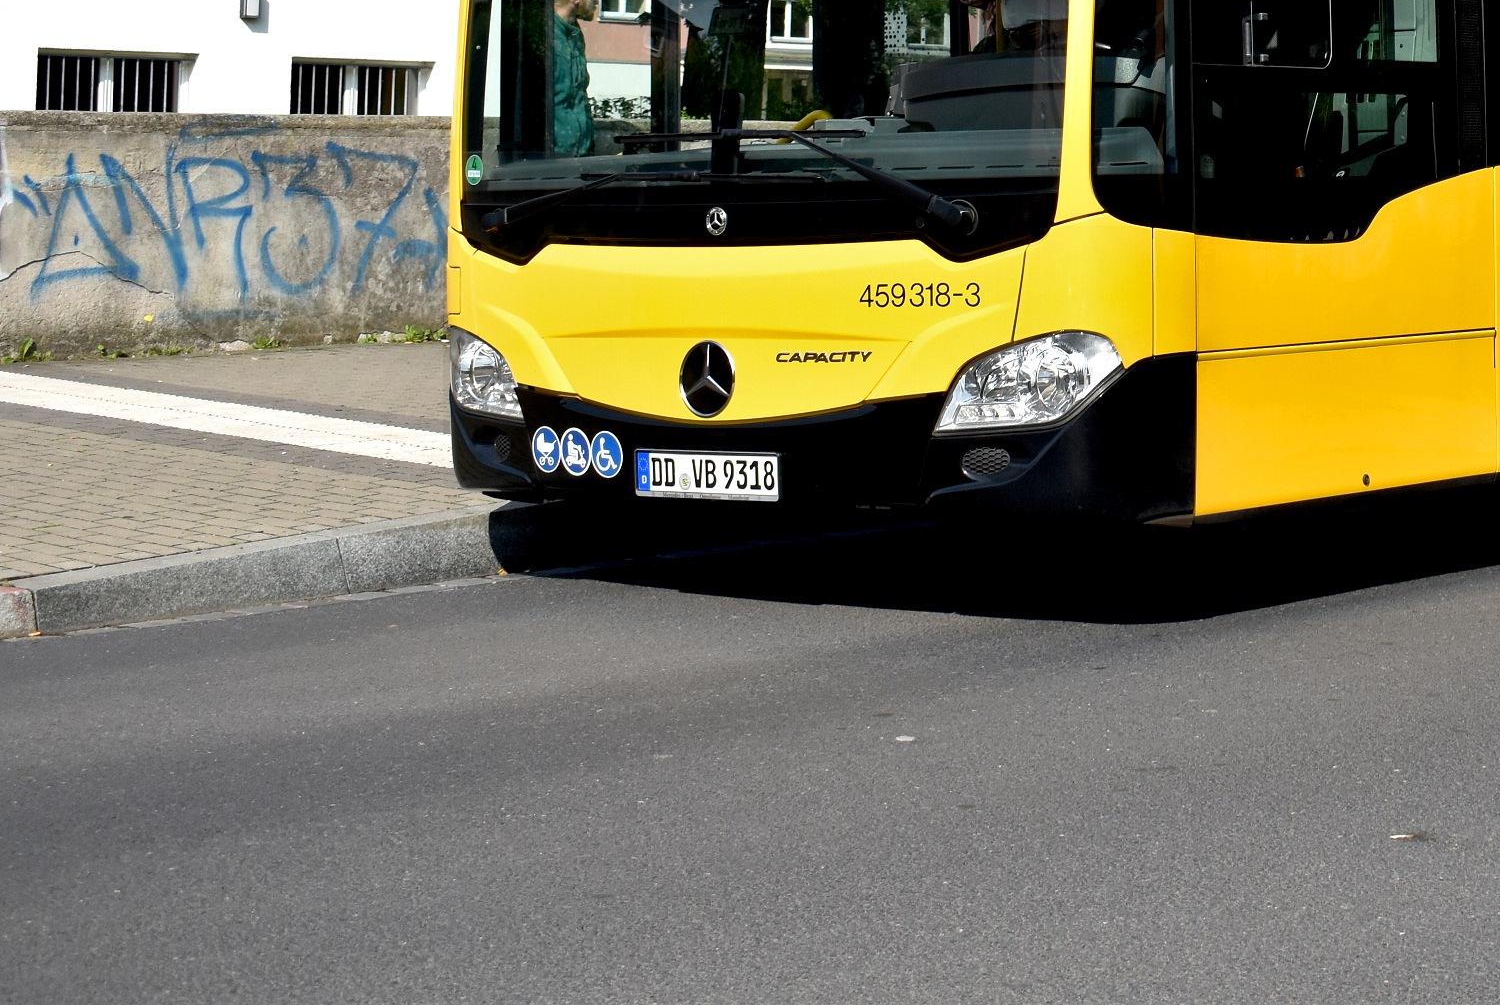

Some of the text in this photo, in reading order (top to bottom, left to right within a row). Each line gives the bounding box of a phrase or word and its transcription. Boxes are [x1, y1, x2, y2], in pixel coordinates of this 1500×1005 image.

[471, 157, 477, 170] 4
[775, 351, 872, 364] CAPACITY
[651, 457, 776, 491] DD VB 9318
